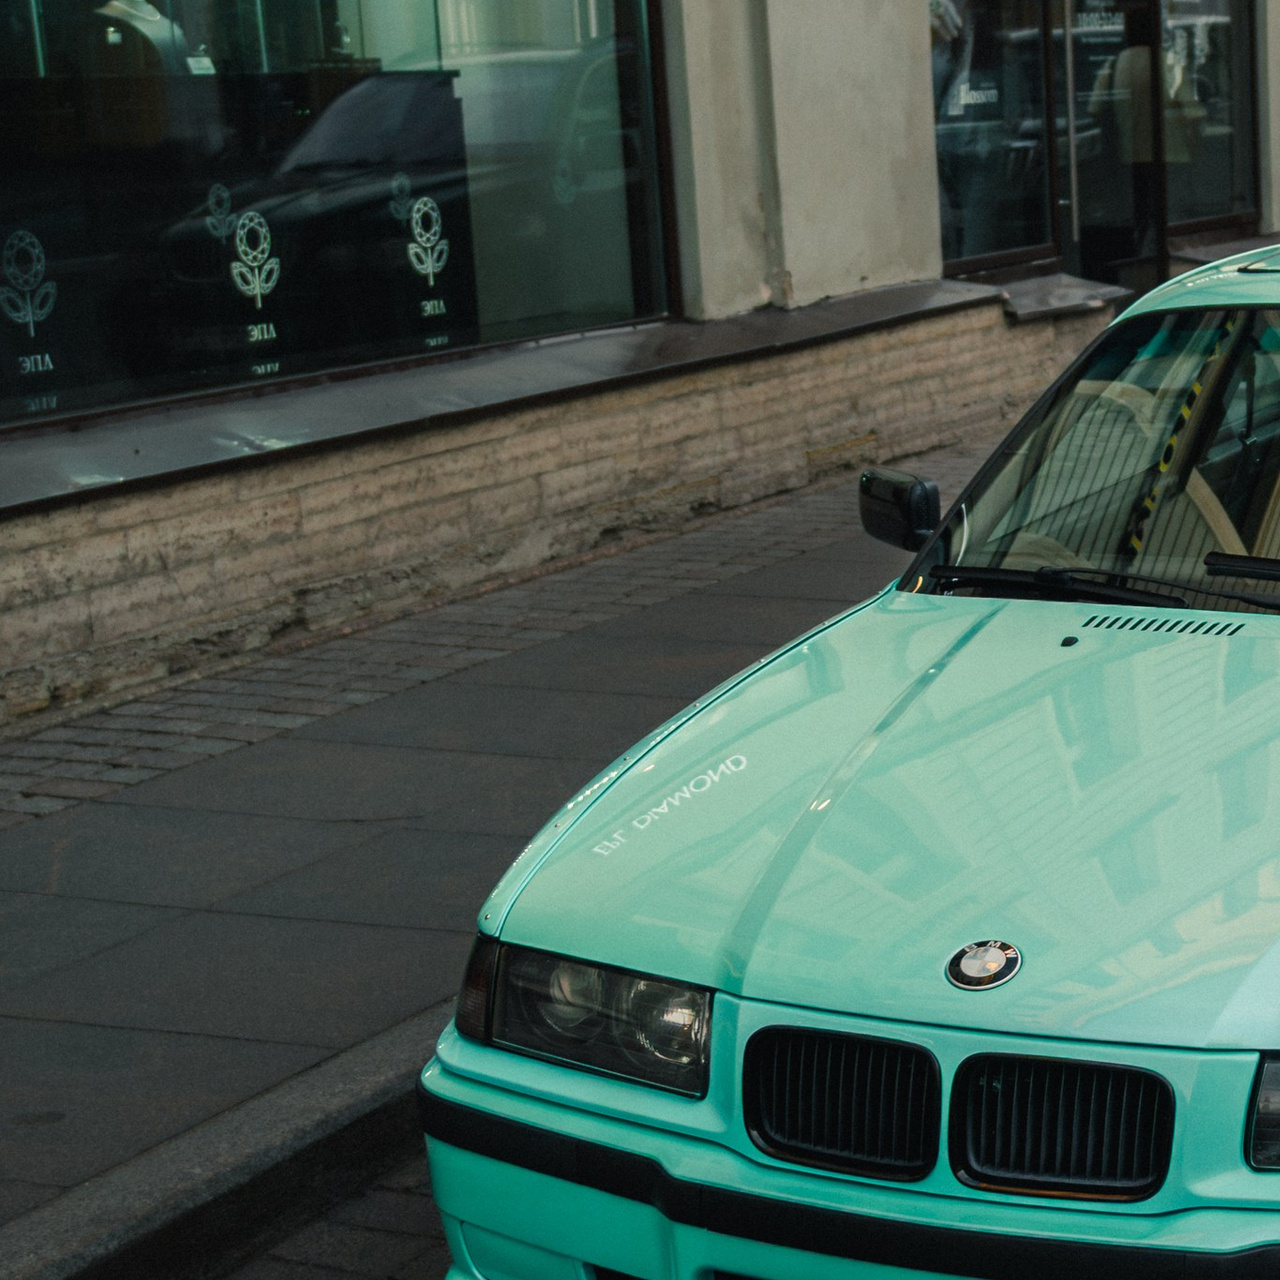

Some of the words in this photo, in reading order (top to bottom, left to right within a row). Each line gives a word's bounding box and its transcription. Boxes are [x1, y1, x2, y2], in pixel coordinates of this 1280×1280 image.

[420, 298, 447, 317] ЭПЛ
[247, 322, 277, 342] ЭПЛ
[19, 353, 54, 374] ЭПЛ
[963, 940, 1018, 958] BMW
